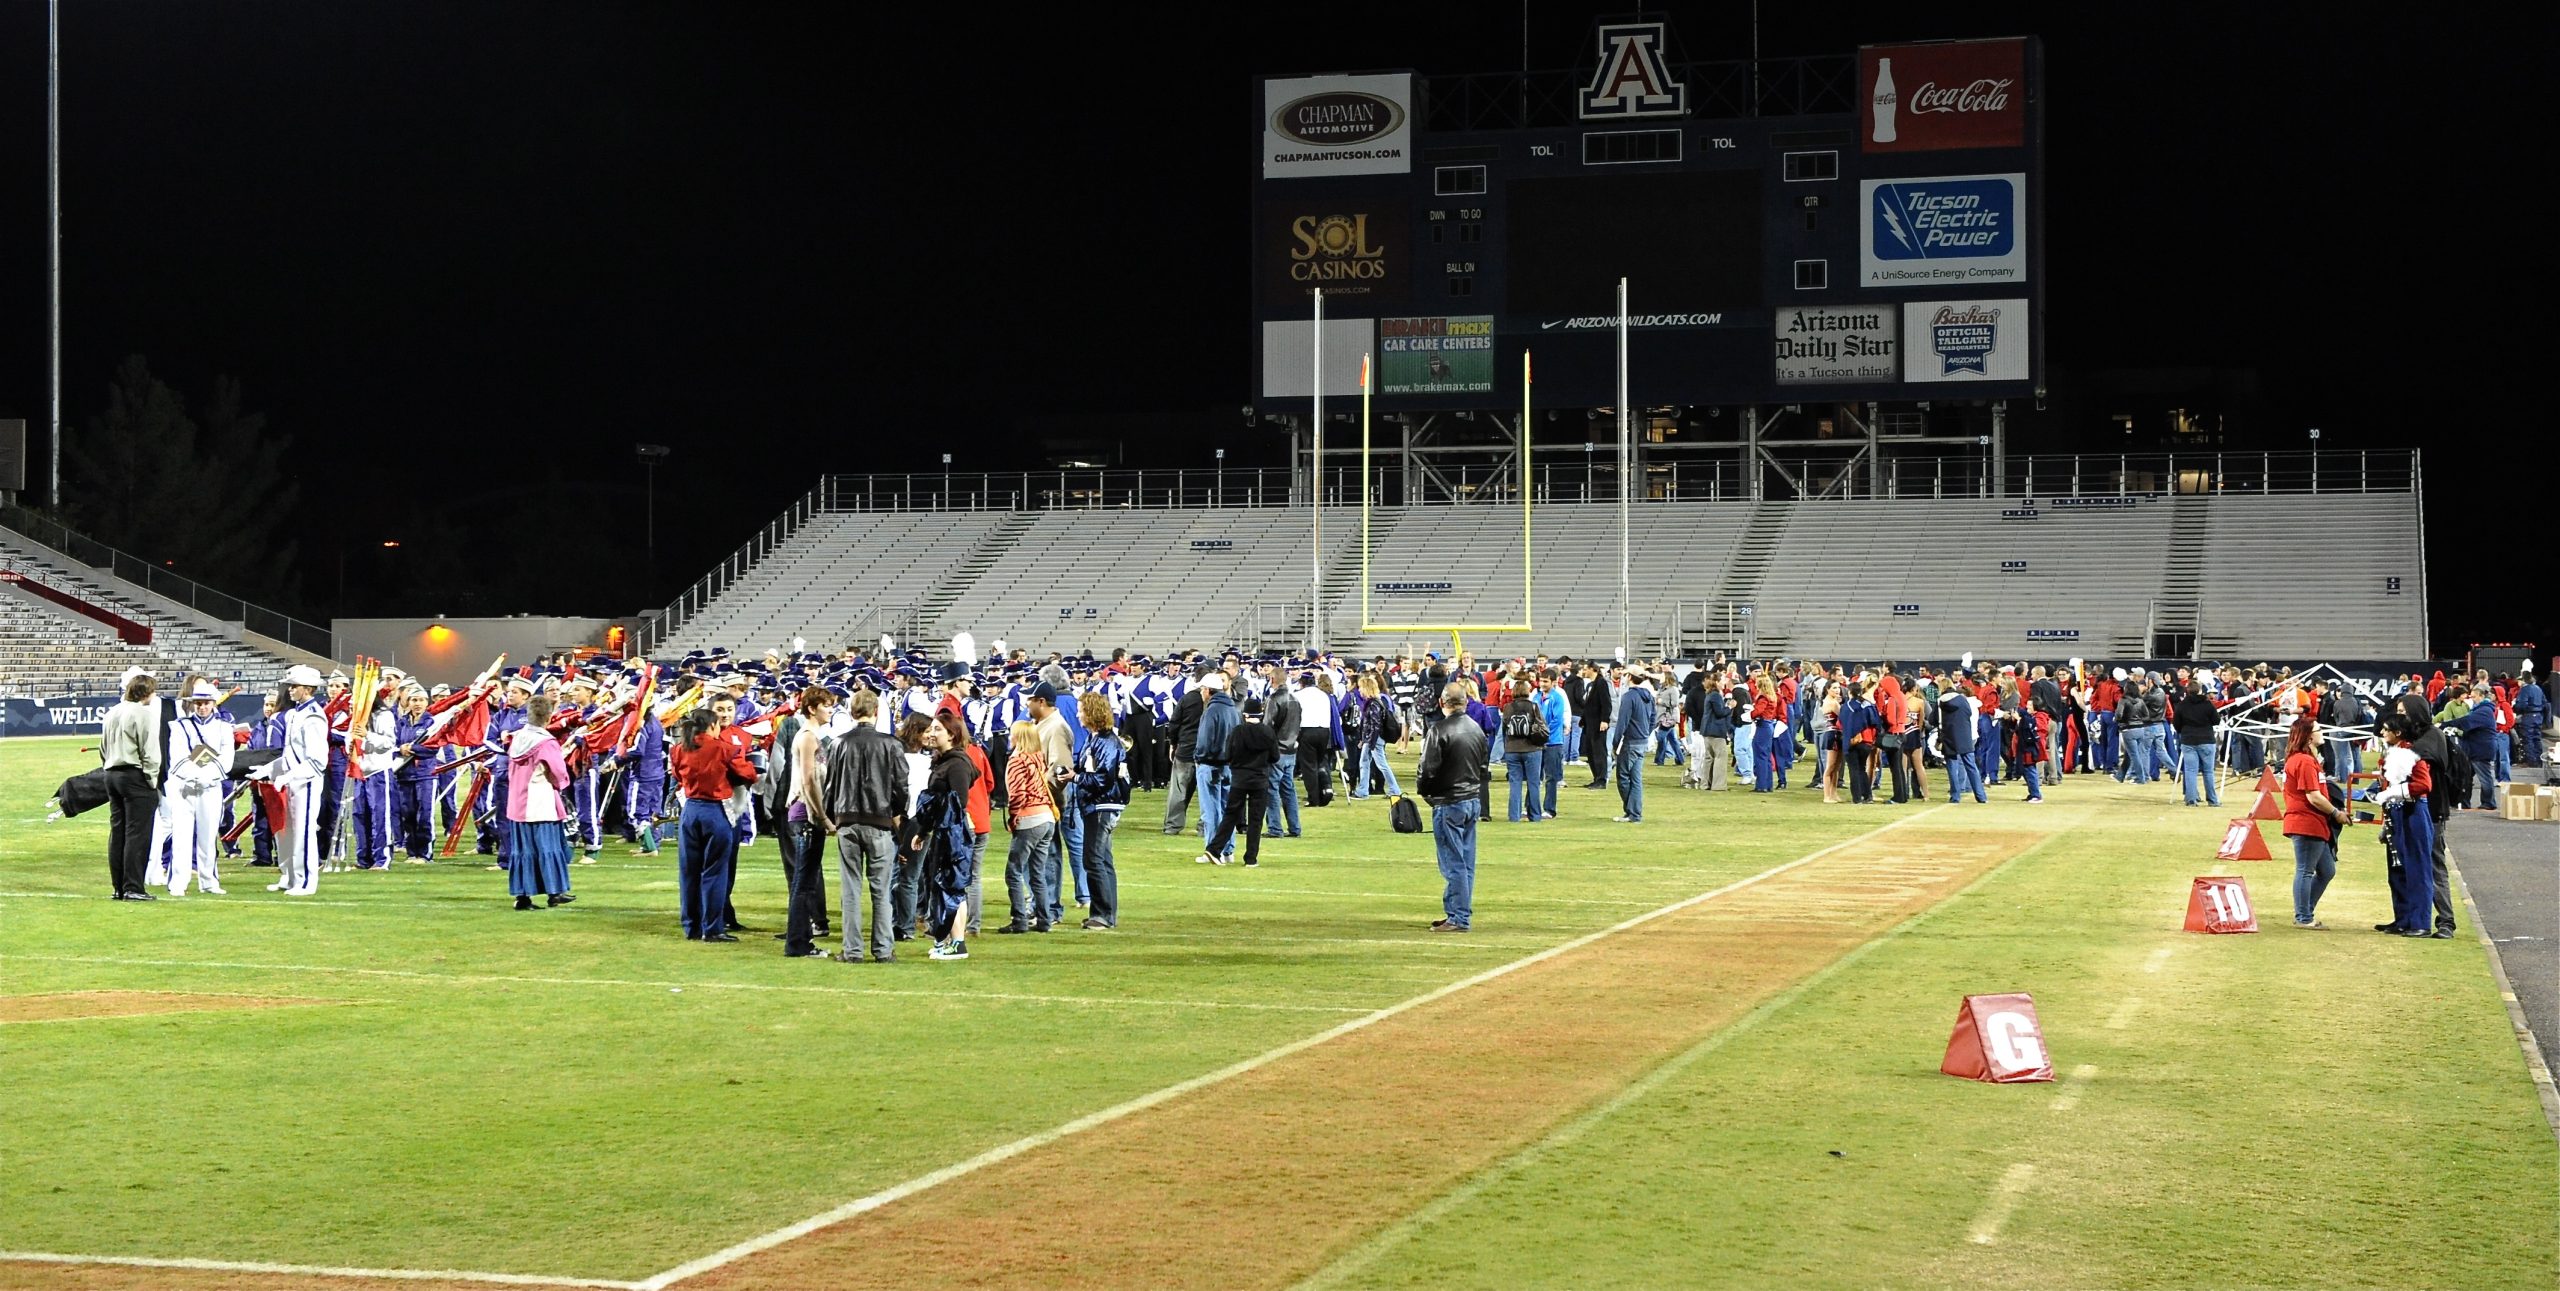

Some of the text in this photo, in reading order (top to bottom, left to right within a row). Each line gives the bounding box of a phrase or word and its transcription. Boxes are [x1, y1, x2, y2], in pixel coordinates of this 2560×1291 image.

[1579, 22, 1684, 119] A
[1910, 78, 2015, 115] Coca-Cola
[1299, 104, 1375, 124] CHAPMAN
[1300, 124, 1375, 135] AUTOMOTIVE
[1712, 138, 1736, 149] TOL
[1274, 149, 1401, 163] CHAPMANTUCSON.COM
[1530, 146, 1553, 156] TOL
[1804, 196, 1819, 207] QTR
[1907, 192, 1980, 211] Tucson
[1430, 210, 1445, 220] DWN
[1460, 208, 1481, 219] TO GO
[1915, 208, 1999, 228] Electric
[1291, 213, 1384, 260] SOL
[1924, 229, 1999, 248] Power
[1291, 260, 1385, 281] CASINOS
[1446, 262, 1475, 273] BALL ON
[1871, 267, 2015, 280] A UniSource Energy Company
[1788, 309, 1880, 333] Arizona
[1937, 327, 1991, 337] OFFICIAL
[1384, 337, 1491, 352] CAR CARE CENTERS
[1937, 336, 1991, 345] TAILGATE
[1775, 334, 1894, 363] Daily Star
[1776, 368, 1794, 379] It's
[1798, 370, 1806, 378] a
[1809, 366, 1853, 378] Tucson
[1384, 382, 1491, 393] www.brakemax.com
[2310, 429, 2319, 438] 30
[2207, 883, 2250, 922] 10
[1986, 1011, 2045, 1072] G
